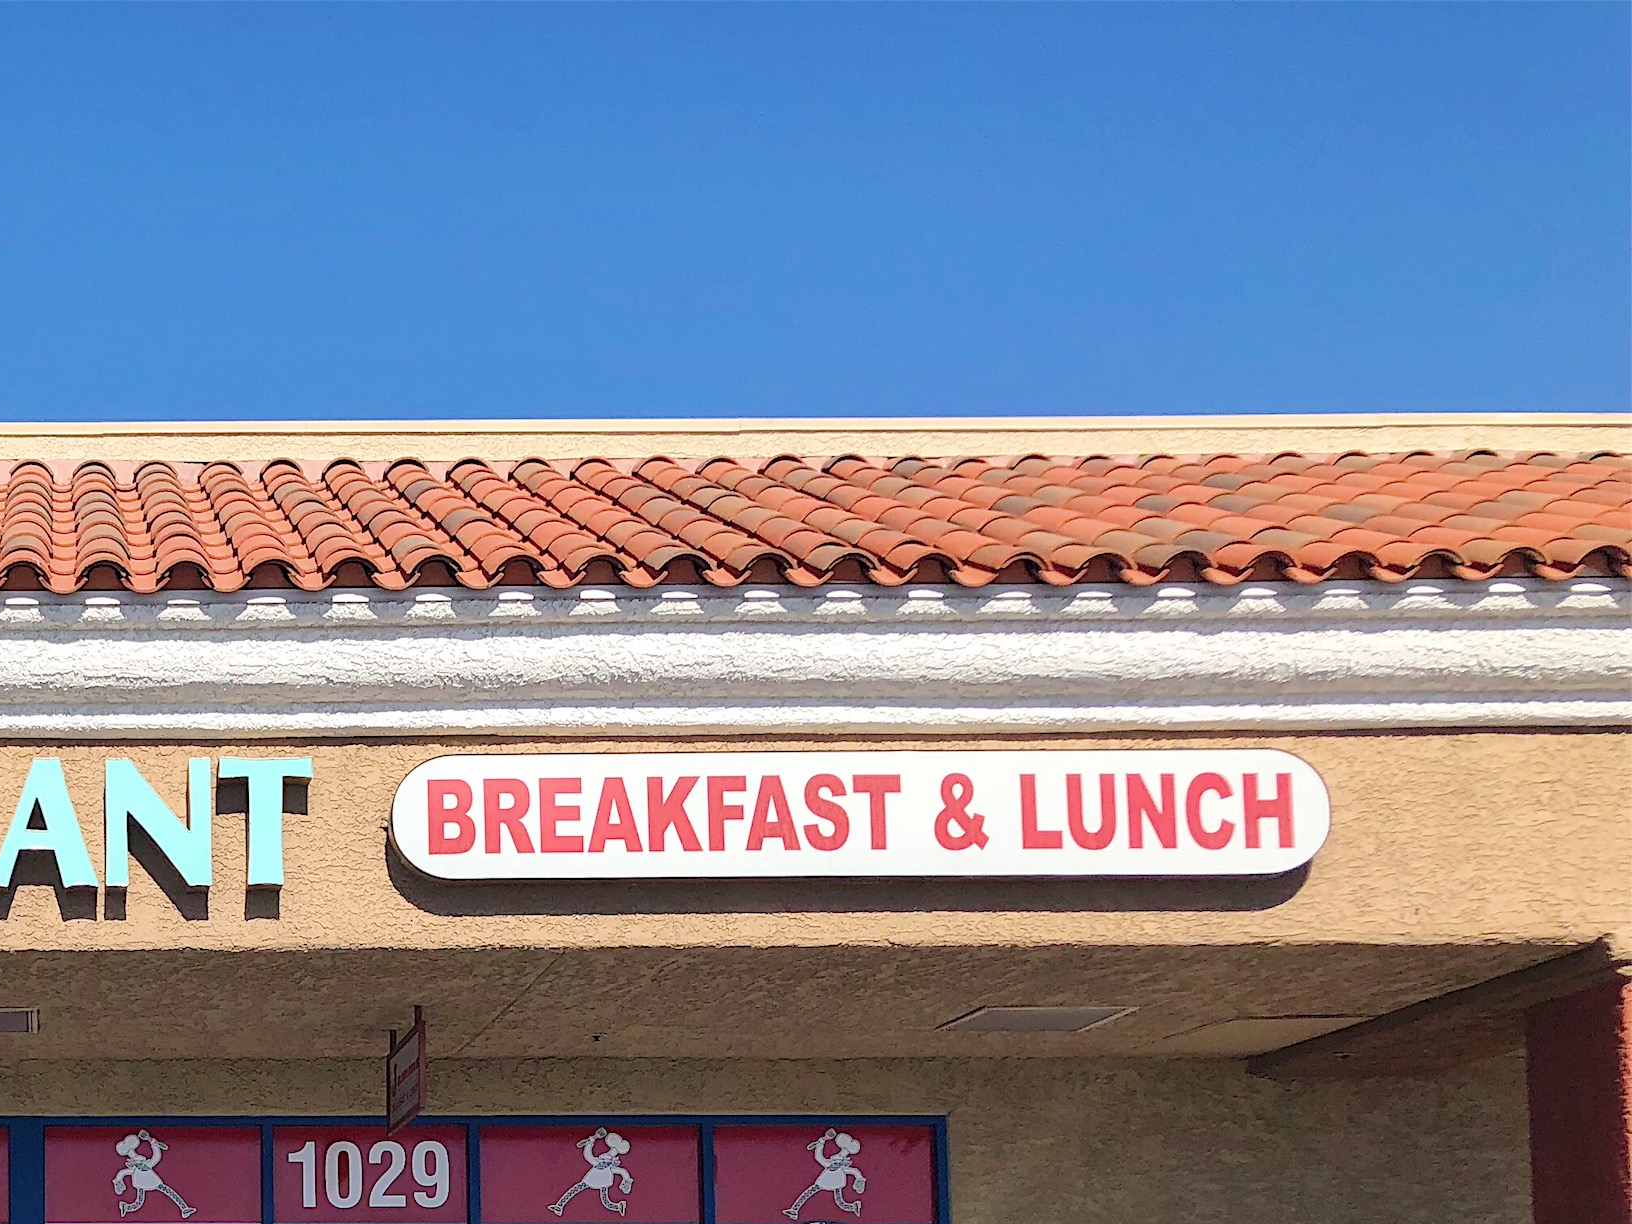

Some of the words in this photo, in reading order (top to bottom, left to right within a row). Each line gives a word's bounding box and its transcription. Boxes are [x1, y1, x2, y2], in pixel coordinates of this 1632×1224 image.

[426, 773, 901, 856] BREAKFAST
[933, 772, 989, 852] &
[1020, 770, 1294, 852] LUNCH
[287, 1140, 450, 1209] 1029
